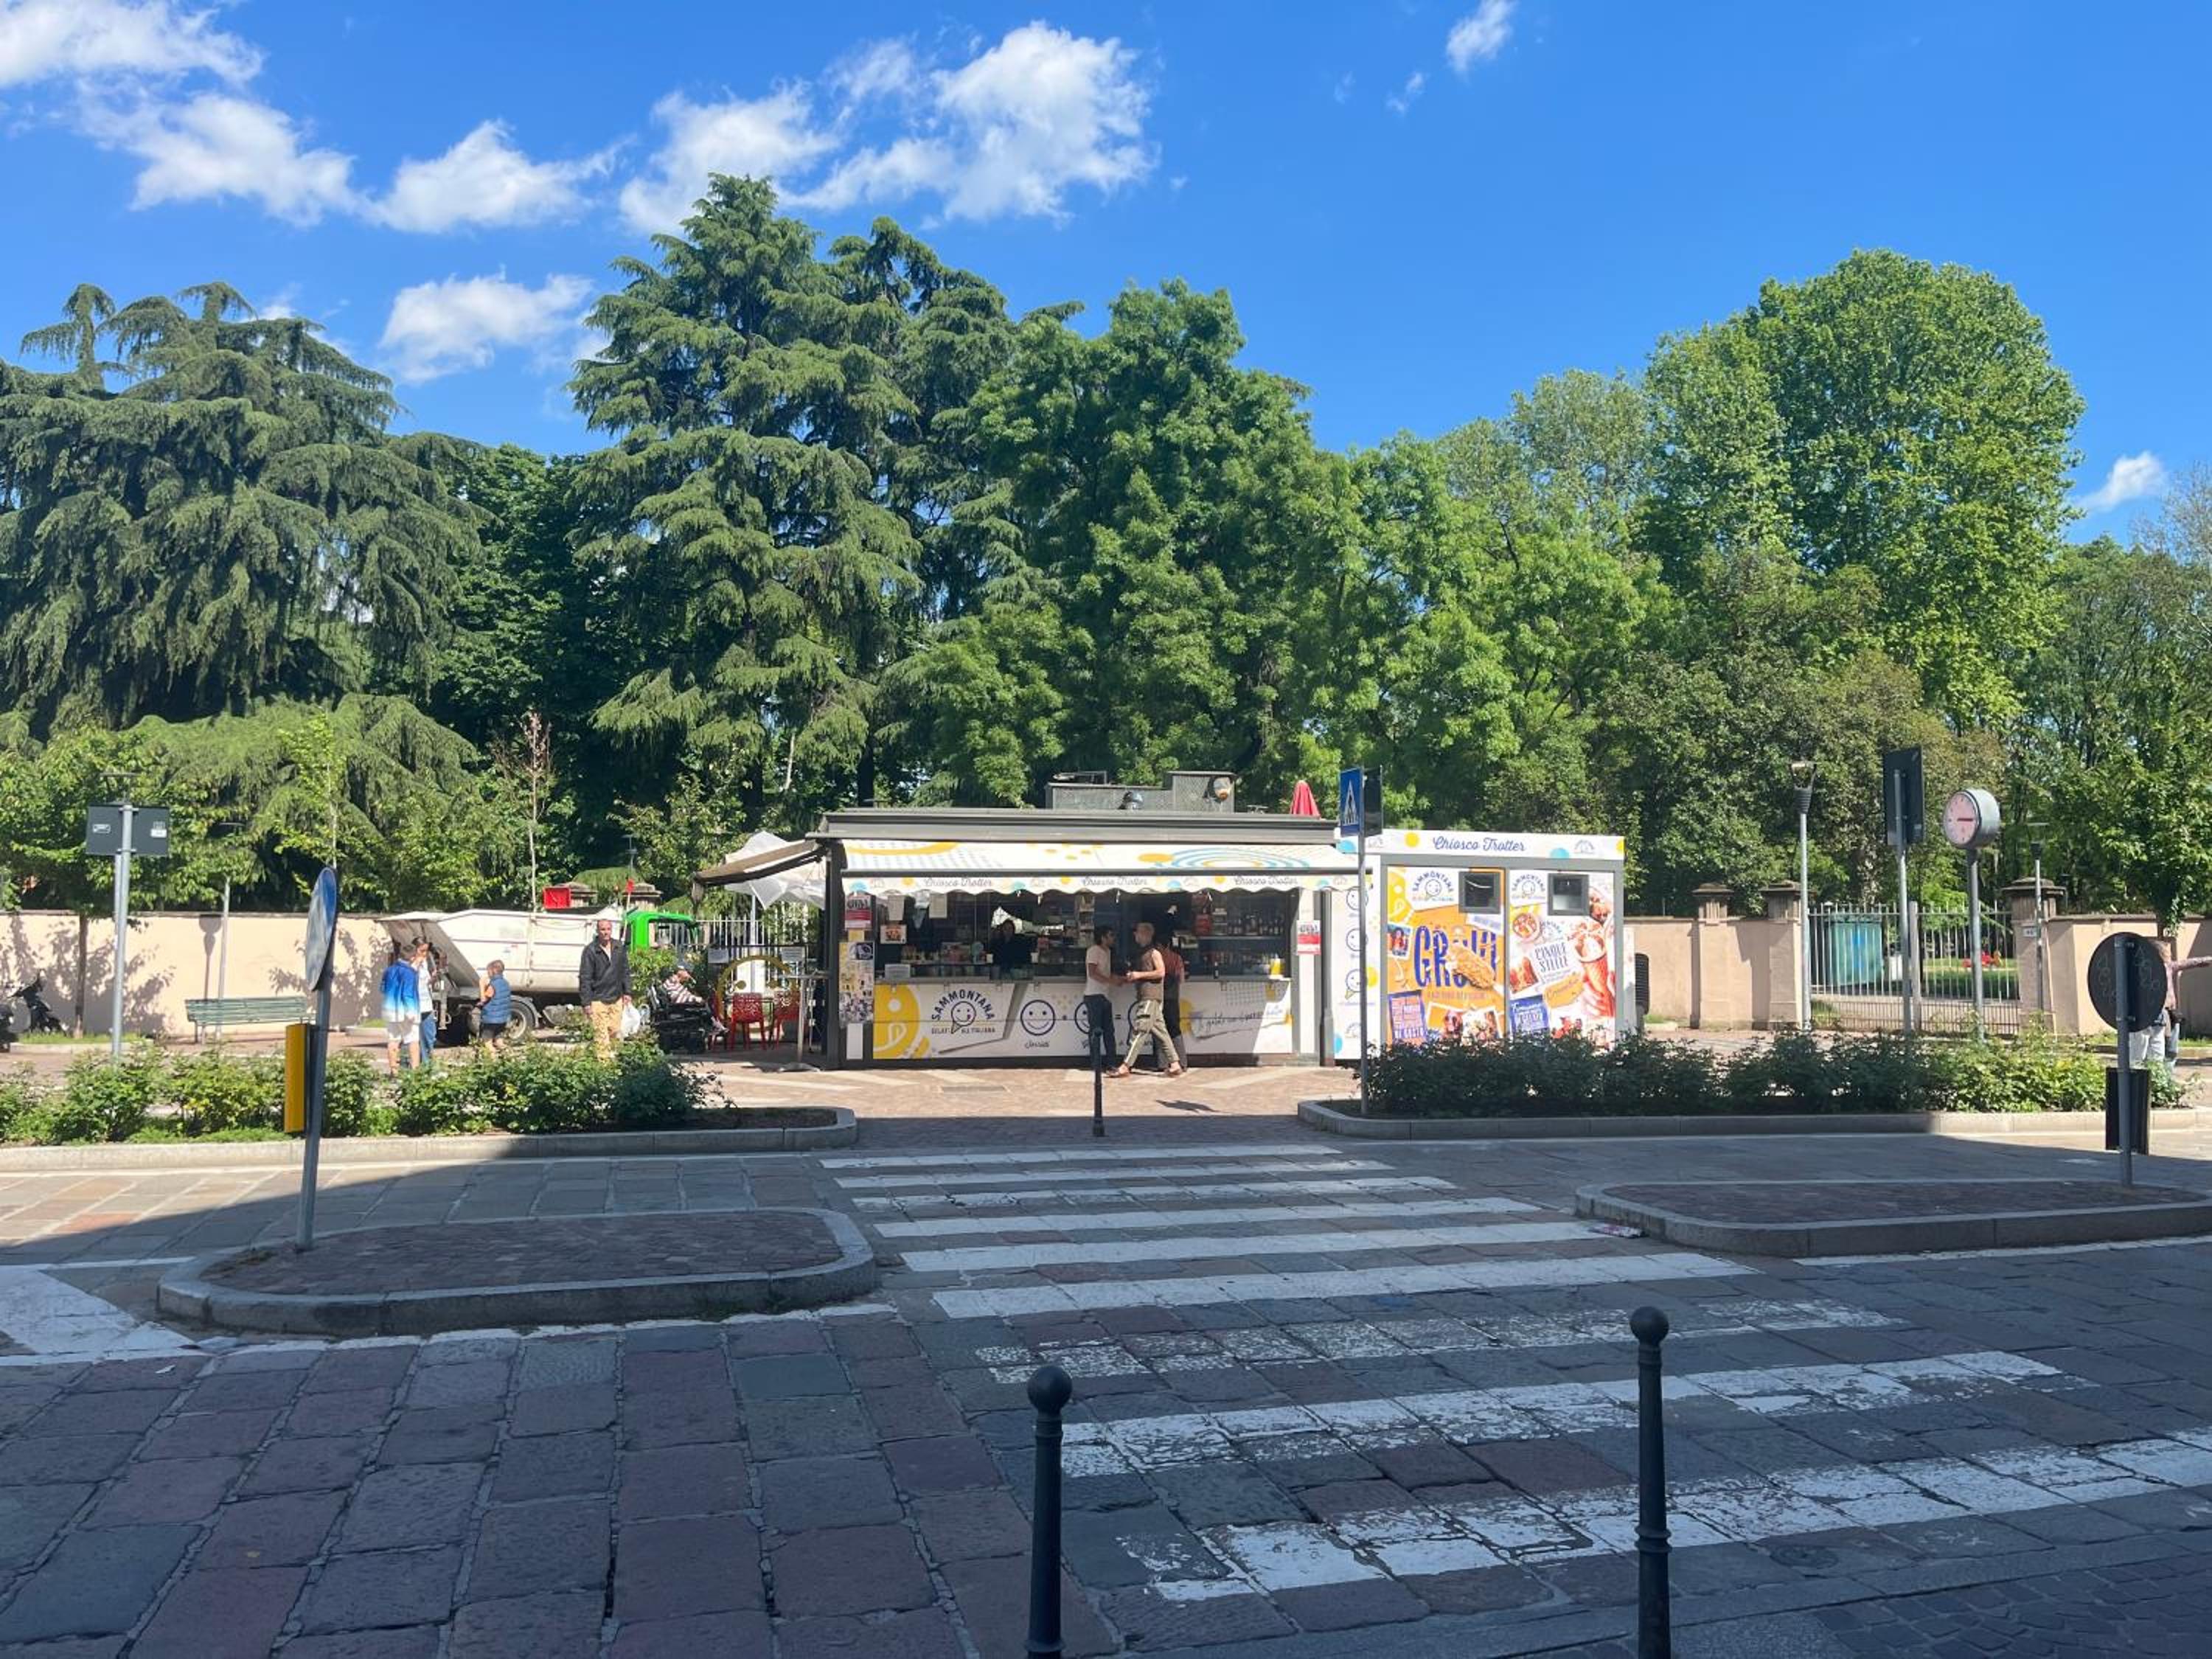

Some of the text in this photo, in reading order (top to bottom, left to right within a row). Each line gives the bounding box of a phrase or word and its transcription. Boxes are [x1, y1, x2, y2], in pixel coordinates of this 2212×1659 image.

[1433, 835, 1525, 852] Chiosco Trotter
[931, 989, 995, 1021] SAMMONTANA
